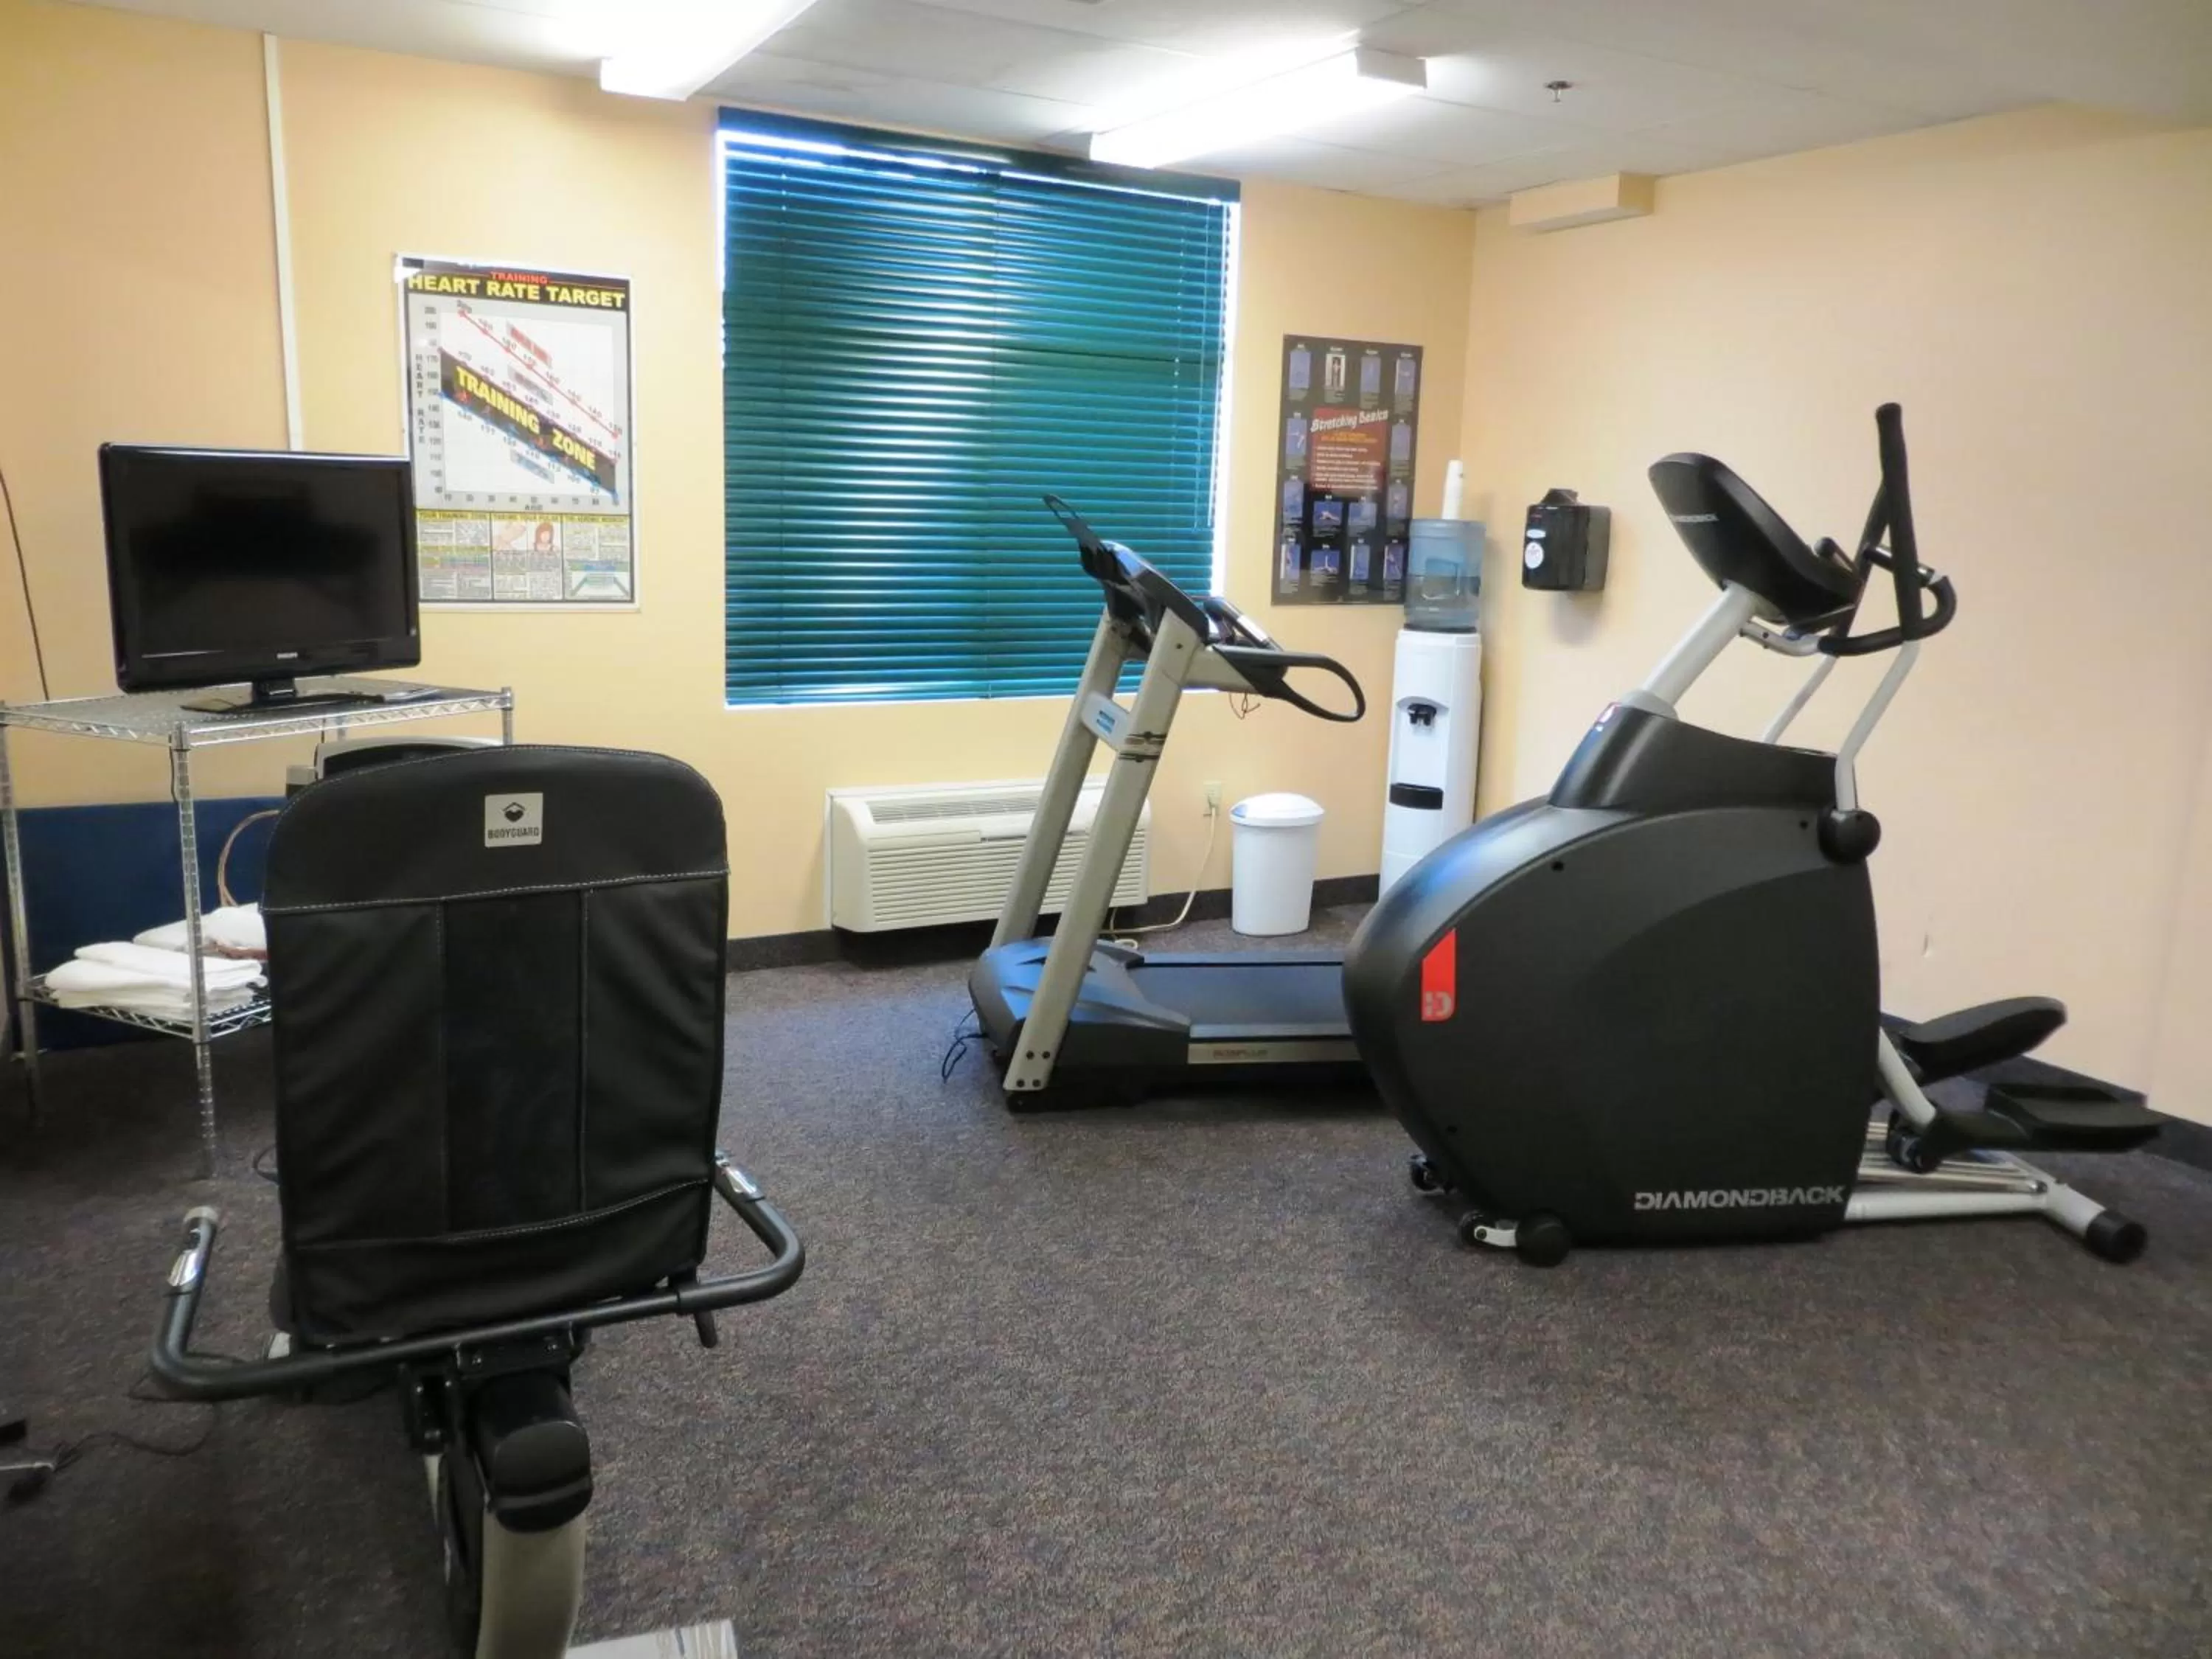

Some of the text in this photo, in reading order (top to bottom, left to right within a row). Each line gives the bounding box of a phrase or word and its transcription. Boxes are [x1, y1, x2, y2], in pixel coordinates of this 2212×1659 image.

[490, 271, 549, 285] TRAINING
[408, 275, 625, 308] HEART RATE TARGET
[456, 366, 540, 435] TRAINING
[552, 434, 596, 471] ZONE
[1310, 414, 1357, 433] Stretching
[487, 827, 540, 839] BODYGUARD
[1633, 1185, 1845, 1211] DIAMONDBACK
